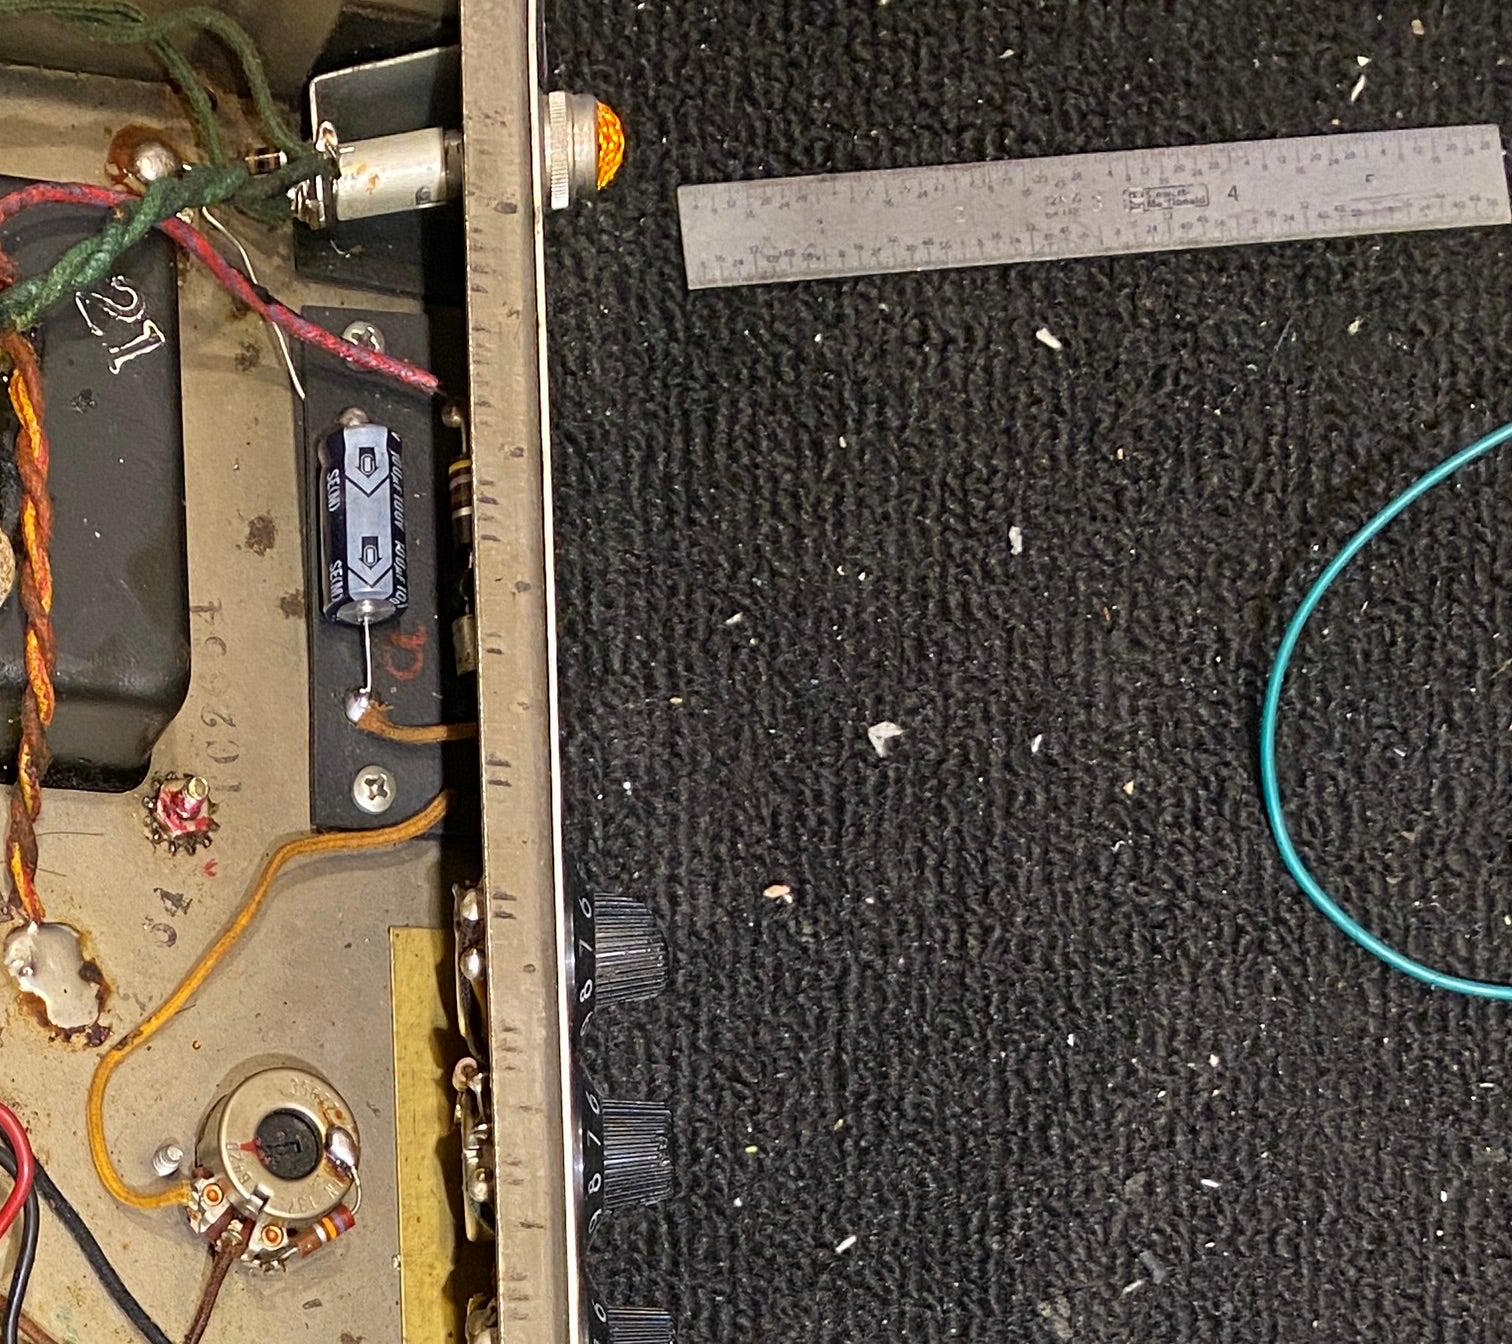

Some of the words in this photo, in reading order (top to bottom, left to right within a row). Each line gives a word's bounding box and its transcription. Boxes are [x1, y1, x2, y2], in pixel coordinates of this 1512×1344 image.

[1226, 184, 1239, 201] 4
[392, 490, 405, 533] 100V
[579, 978, 593, 1003] 8
[588, 1171, 602, 1195] 8
